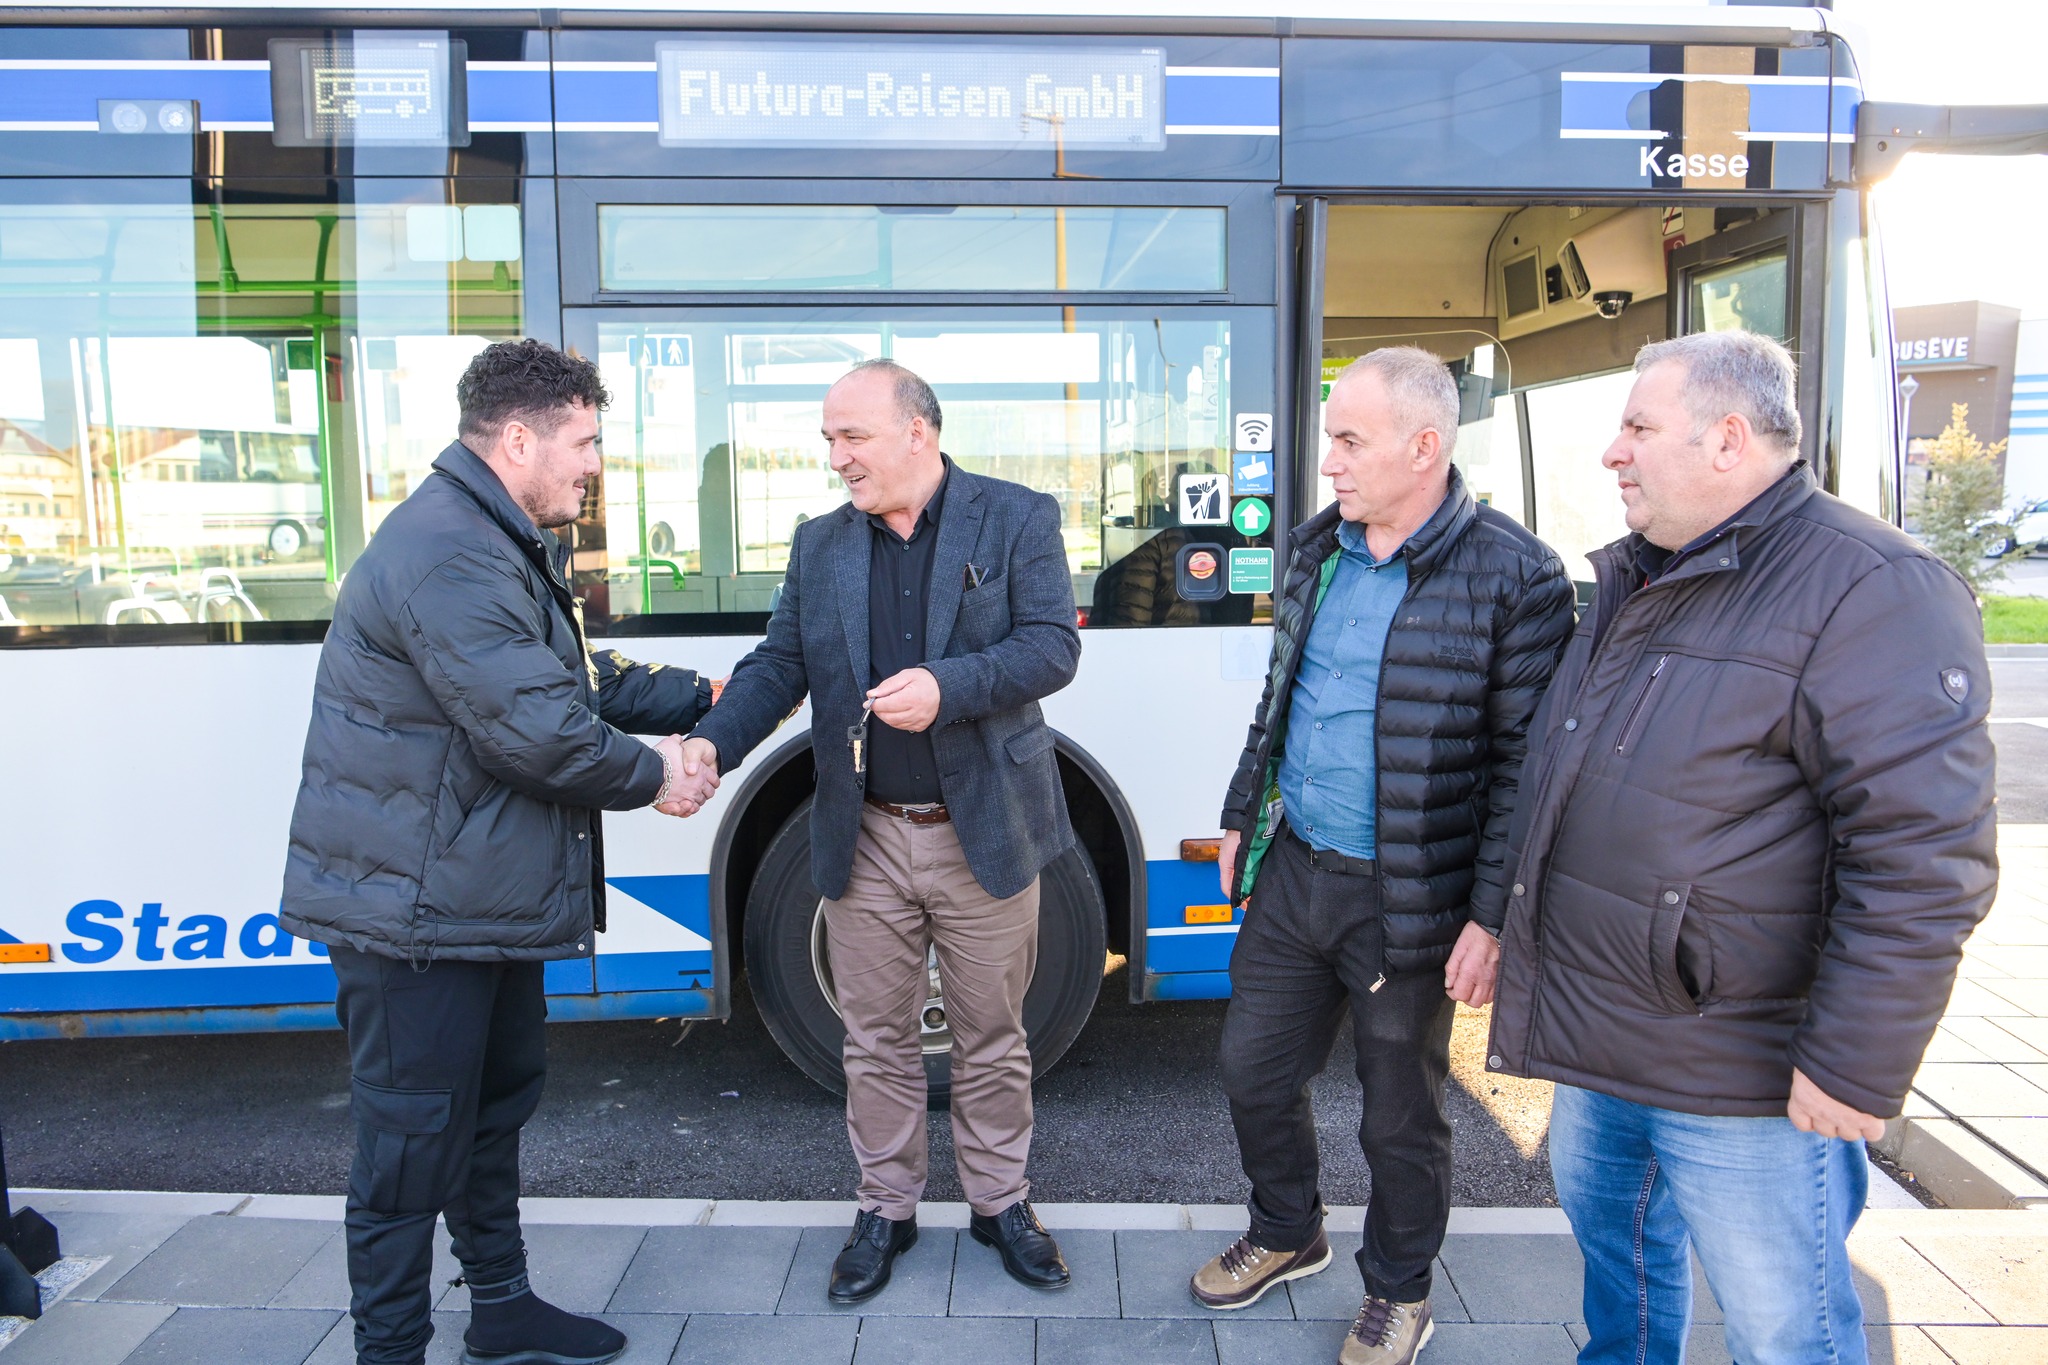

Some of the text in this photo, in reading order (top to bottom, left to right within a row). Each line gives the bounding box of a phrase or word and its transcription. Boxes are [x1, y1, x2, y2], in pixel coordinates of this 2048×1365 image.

[680, 70, 1143, 118] Flutura-Reisen GmbH
[1640, 146, 1749, 178] Kasse
[1321, 366, 1344, 376] TICK
[1235, 557, 1269, 565] NOTHAHN
[1439, 645, 1473, 657] BOSS
[61, 899, 329, 964] Stad
